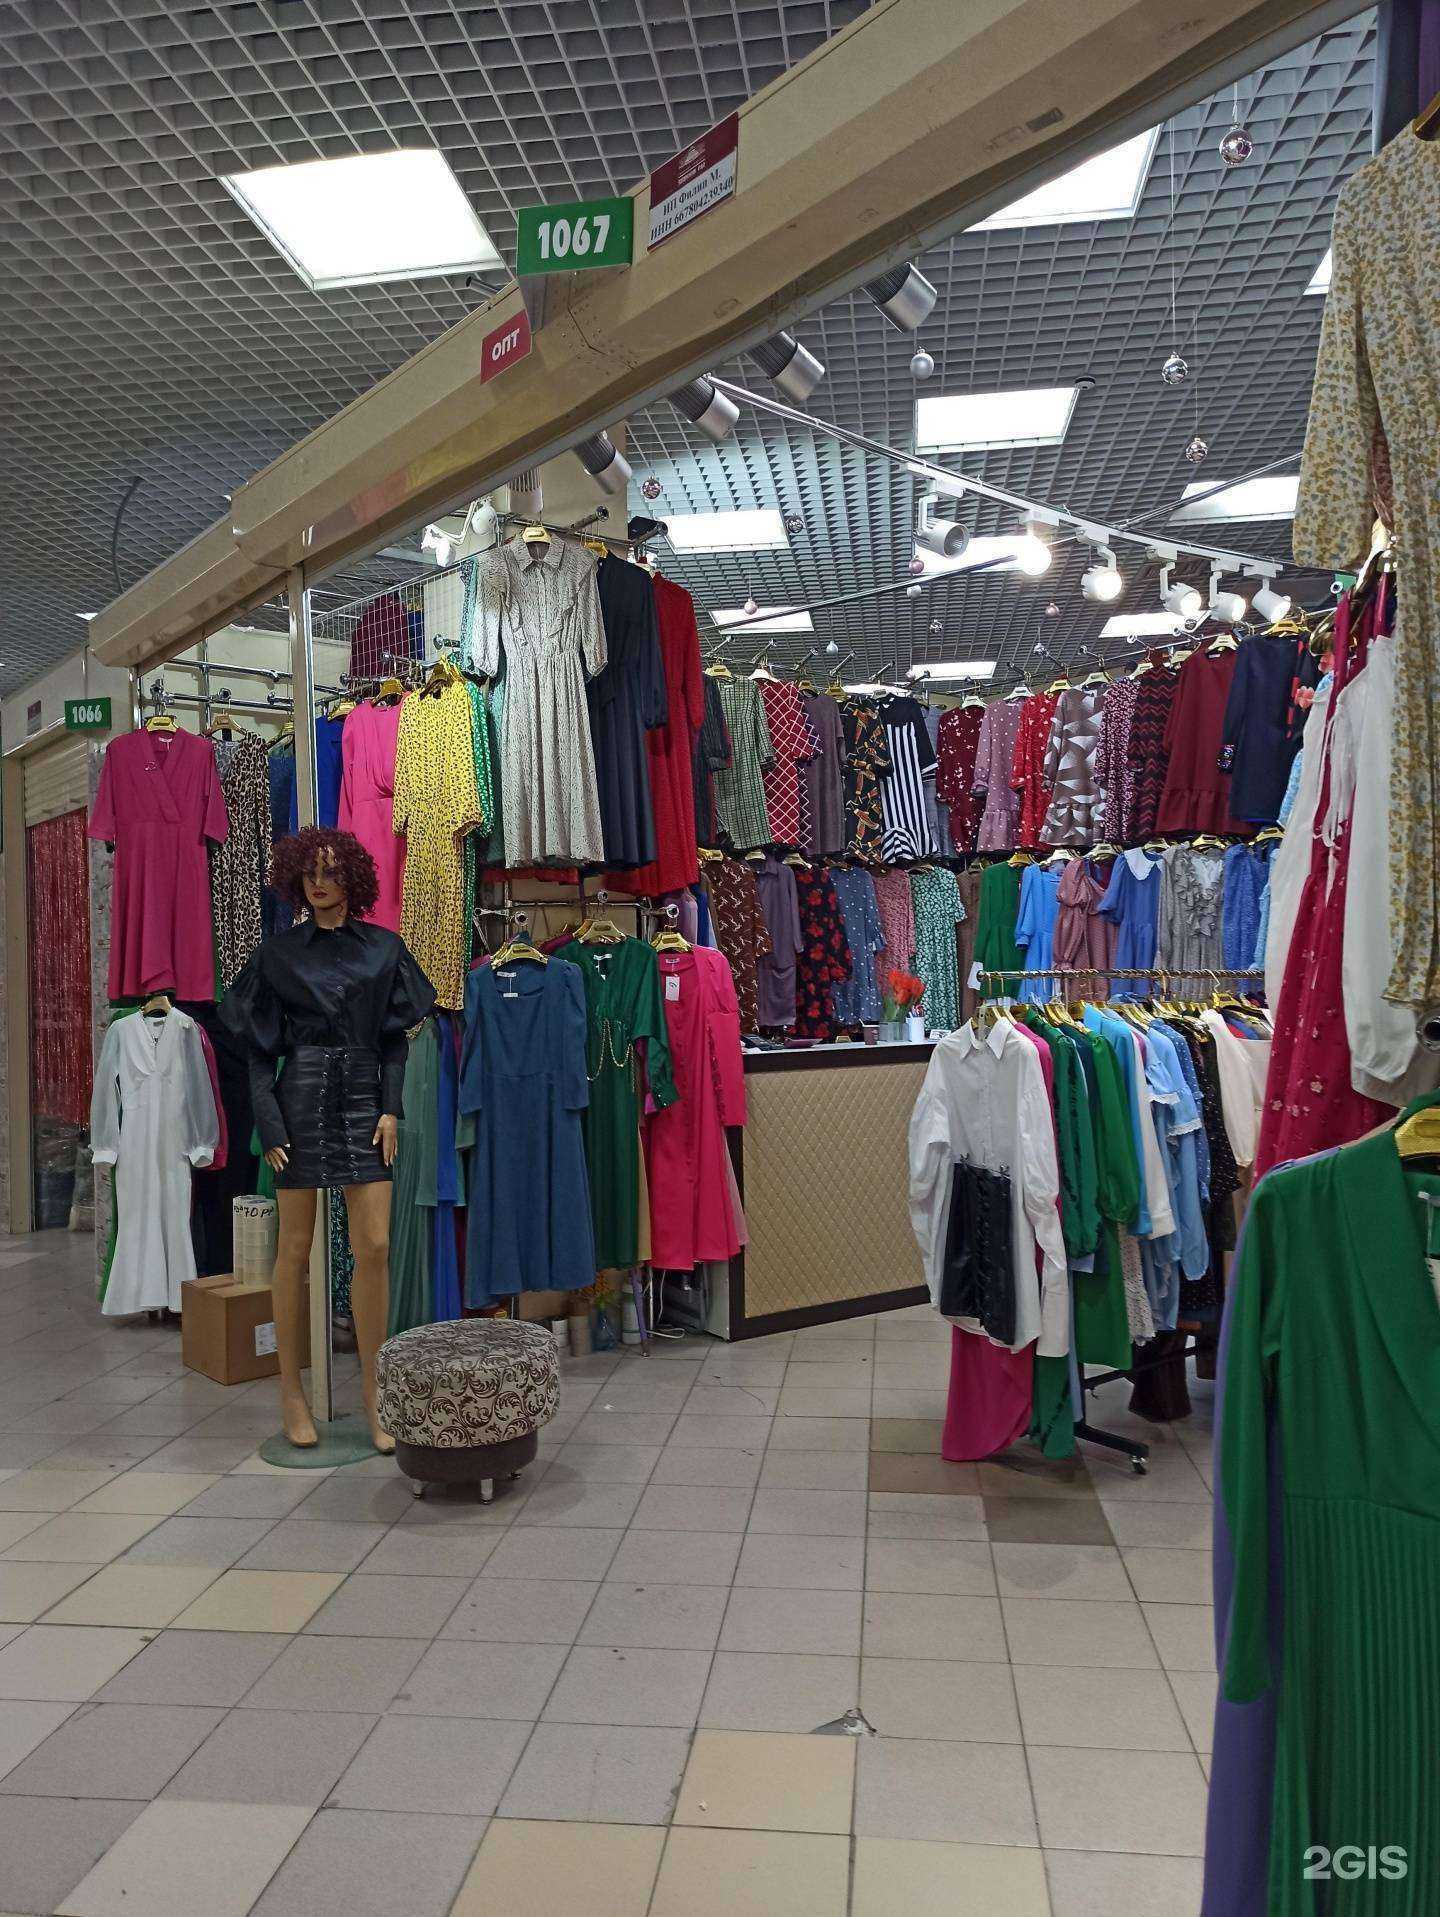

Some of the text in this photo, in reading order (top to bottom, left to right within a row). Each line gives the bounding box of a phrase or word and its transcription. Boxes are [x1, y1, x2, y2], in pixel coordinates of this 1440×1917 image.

[663, 196, 677, 215] ИП
[538, 214, 610, 259] 1067
[650, 218, 672, 241] ИНН
[72, 704, 103, 724] 1066
